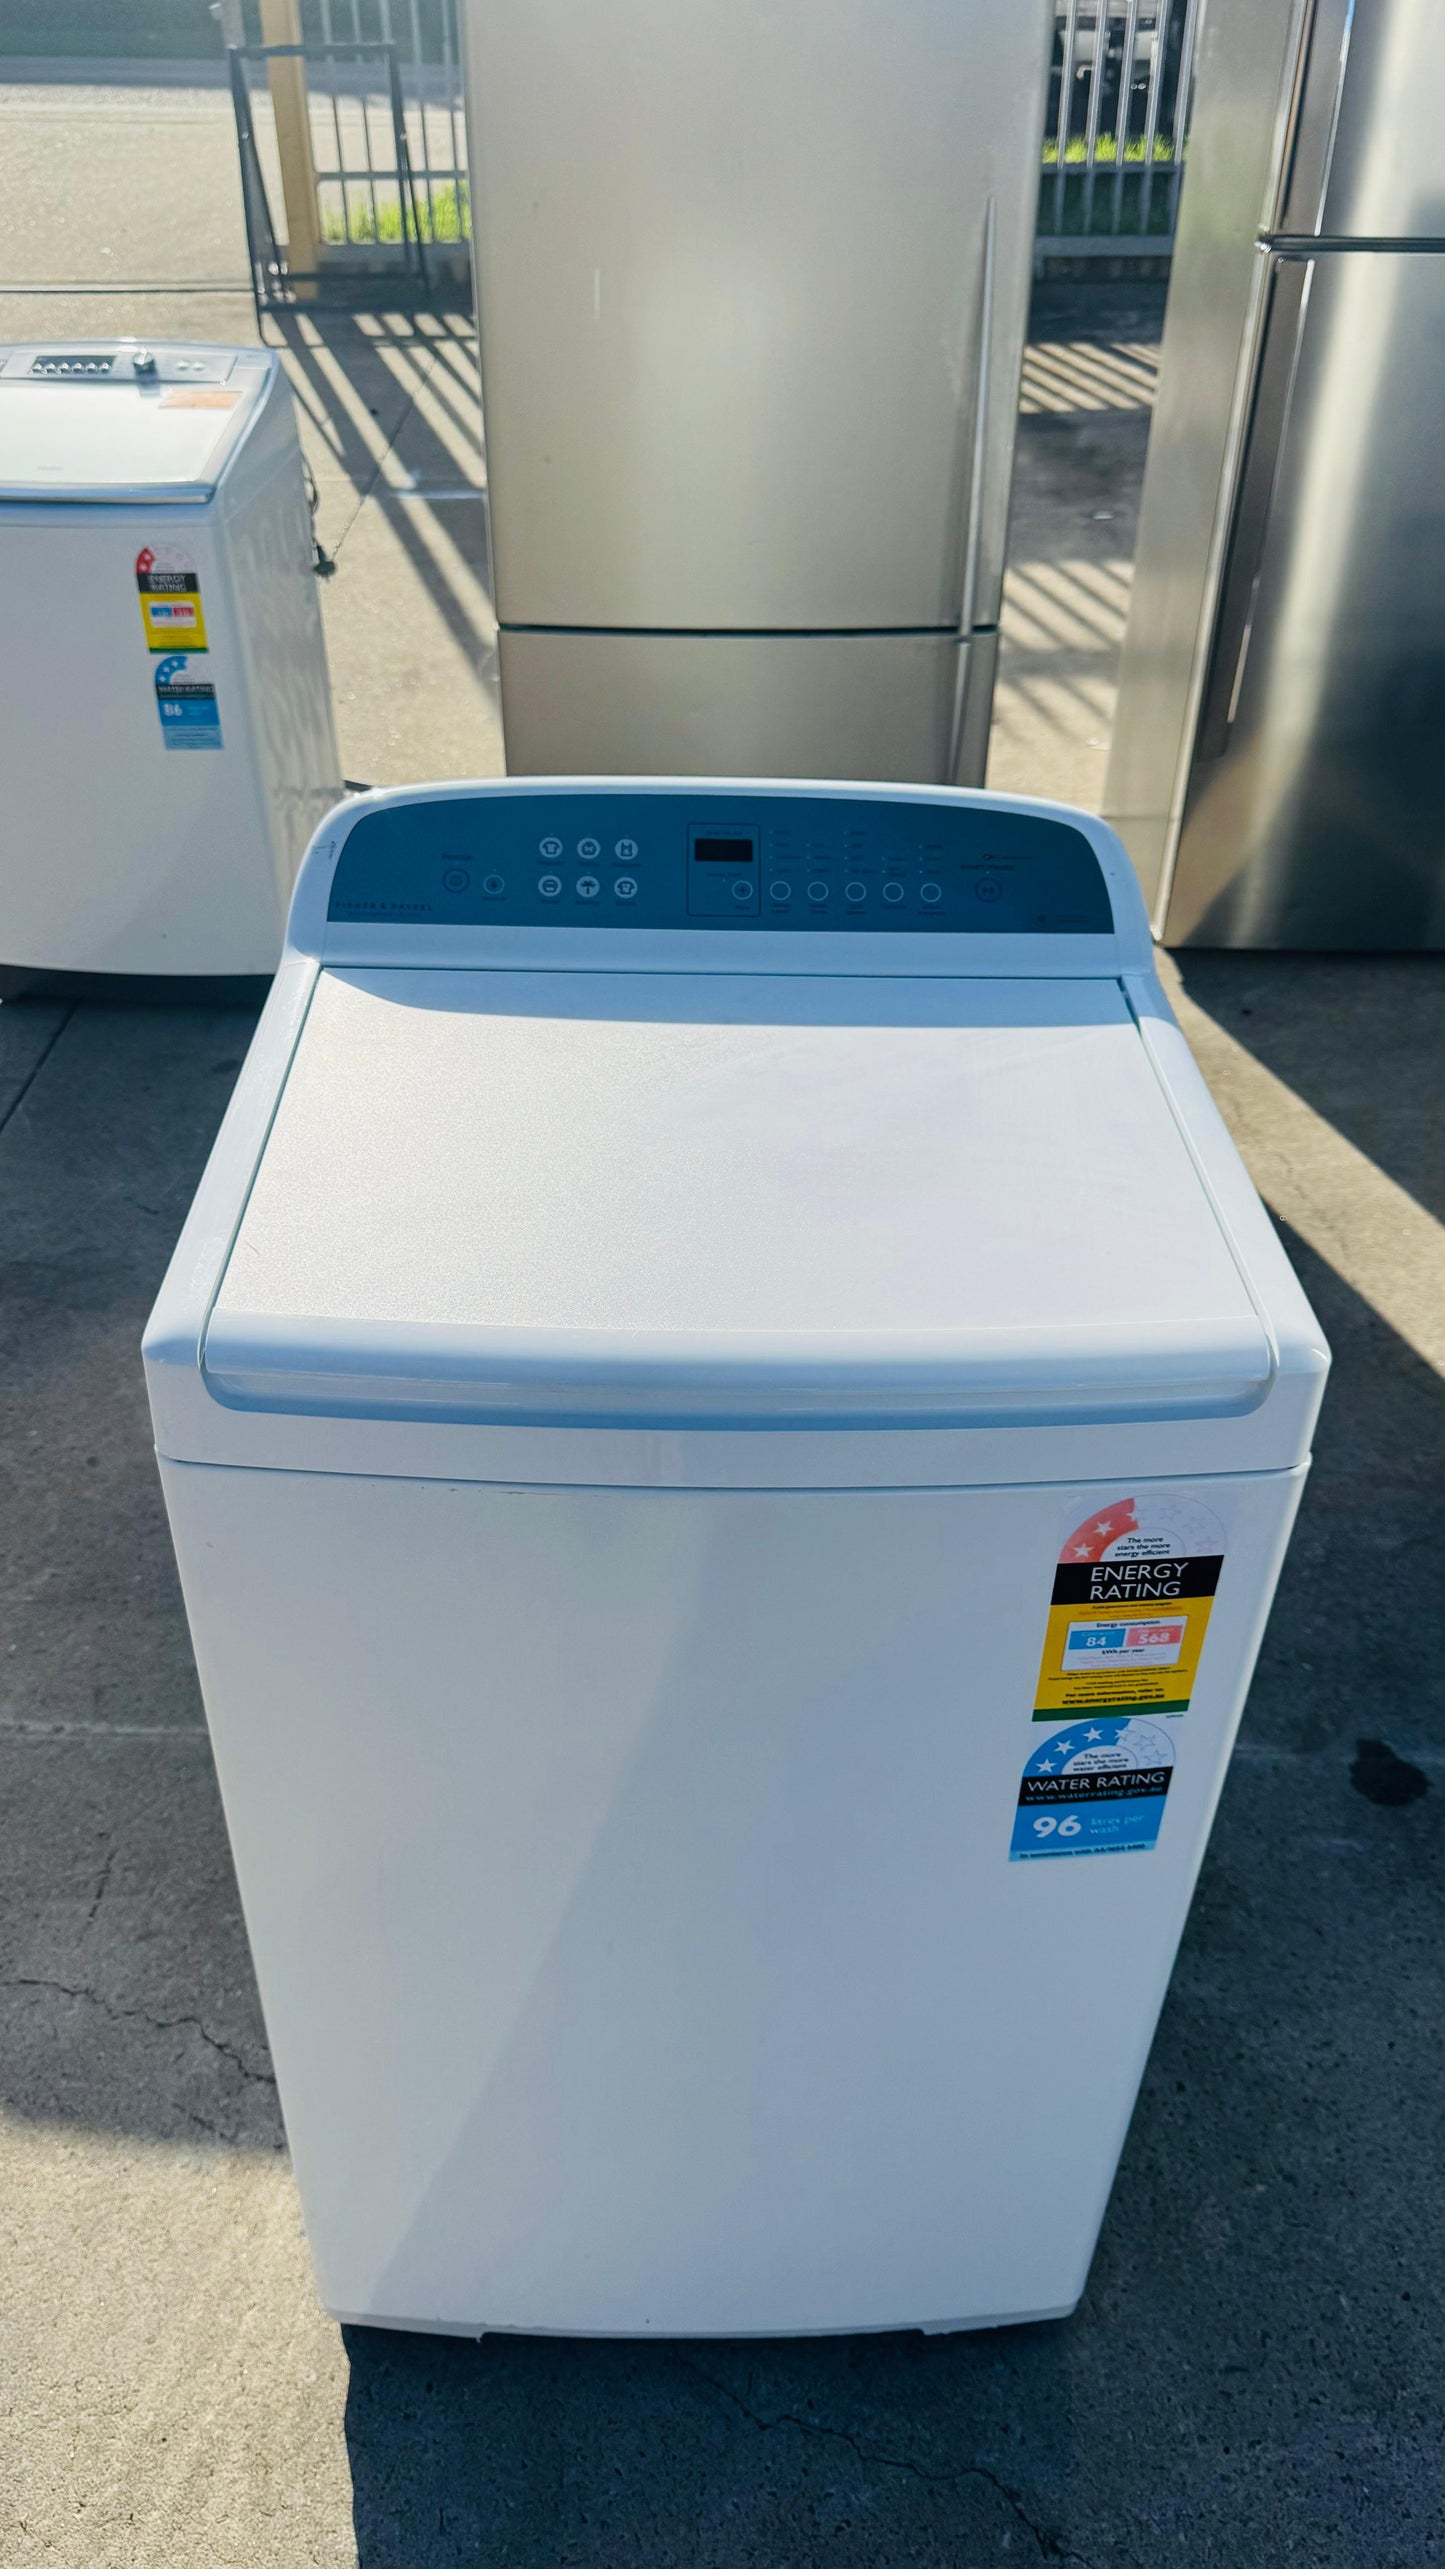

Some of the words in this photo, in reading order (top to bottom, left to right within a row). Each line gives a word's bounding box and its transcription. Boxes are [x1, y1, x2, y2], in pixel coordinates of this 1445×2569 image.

[1143, 1536, 1164, 1544] more
[1137, 1543, 1149, 1551] the
[1151, 1542, 1171, 1550] more
[1114, 1550, 1140, 1558] energy
[1141, 1549, 1171, 1557] efficient
[1090, 1562, 1189, 1582] ENERGY
[1089, 1581, 1182, 1600] RATING
[1096, 1621, 1118, 1629] Energy
[1119, 1619, 1161, 1628] consumption
[1085, 1637, 1107, 1647] 84
[1138, 1633, 1170, 1644] 568
[1062, 1693, 1165, 1705] www.energyrating.gov.au
[1027, 1777, 1091, 1792] WATER
[1096, 1771, 1166, 1788] RATING
[1025, 1785, 1163, 1802] www.waterrating.gov.au
[1091, 1817, 1121, 1826] litres
[1124, 1814, 1145, 1825] per
[1033, 1815, 1082, 1838] 96
[1089, 1825, 1120, 1834] wash
